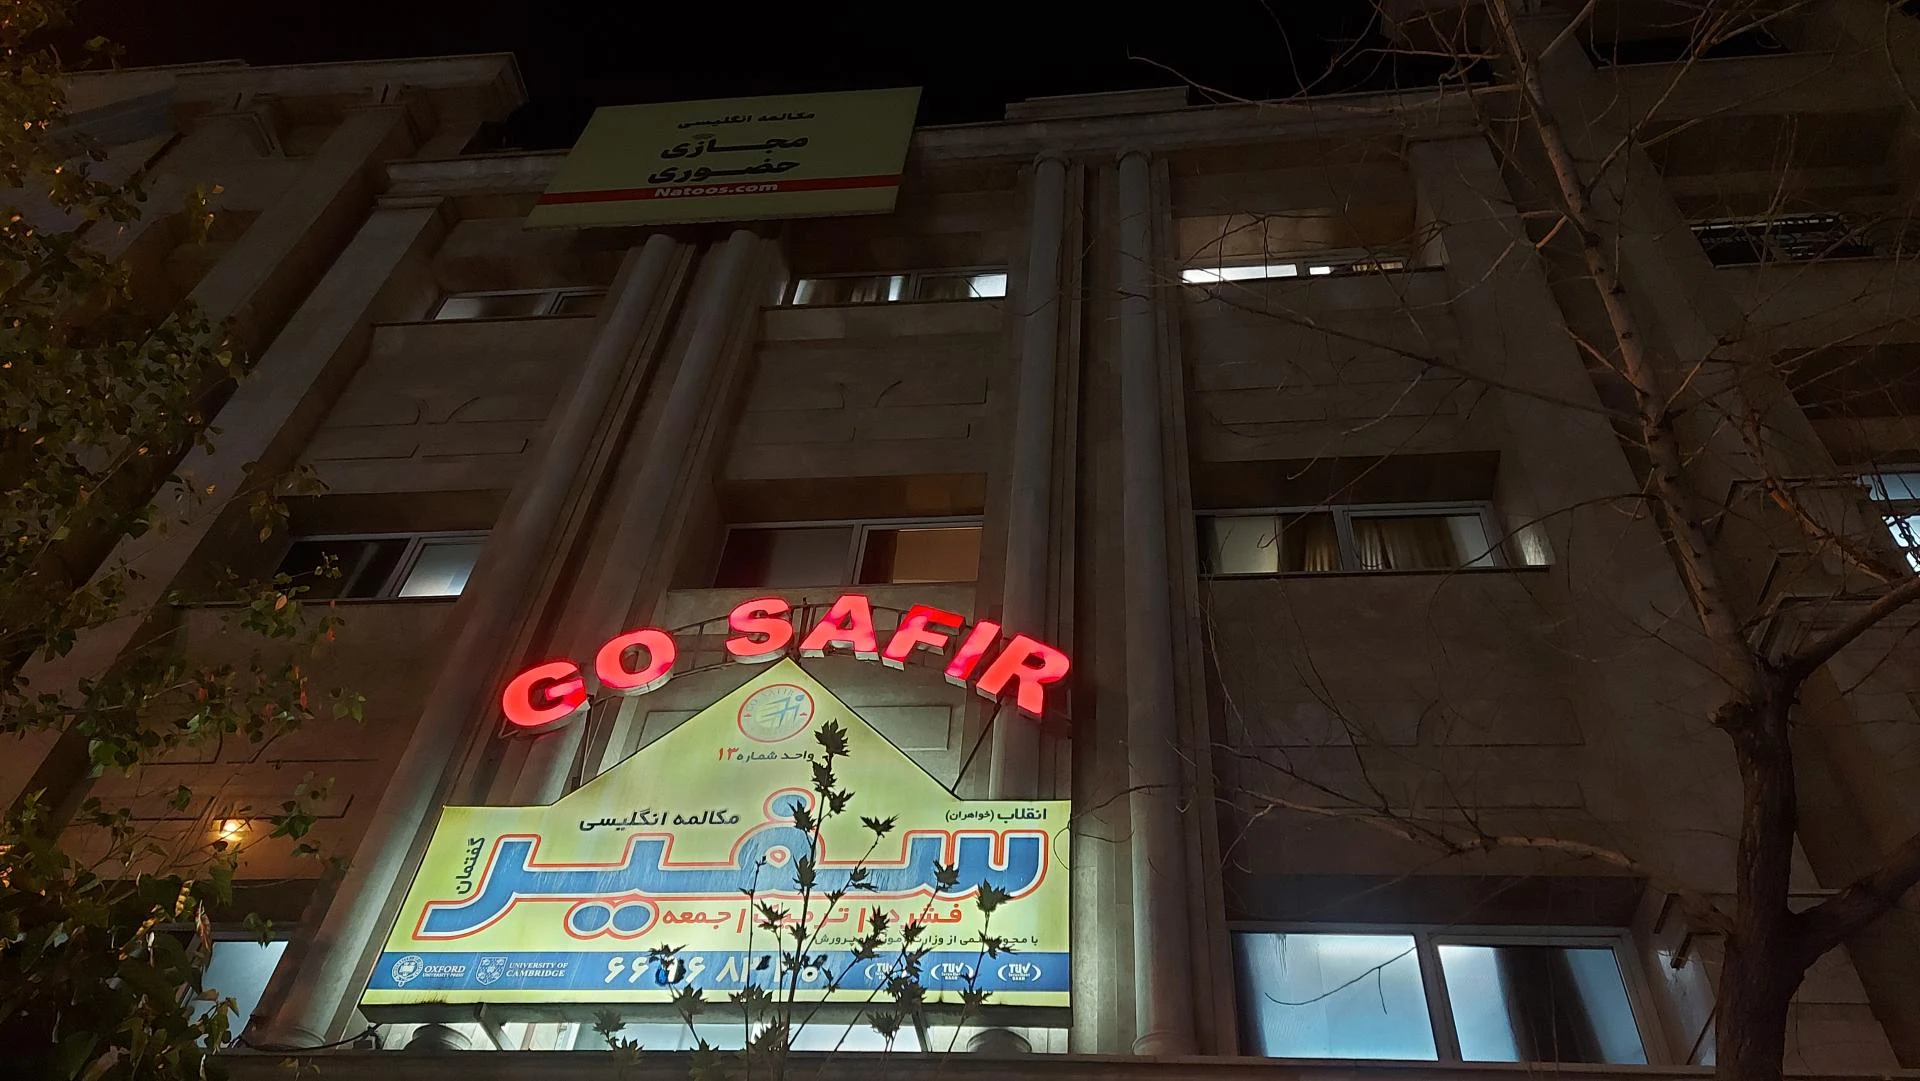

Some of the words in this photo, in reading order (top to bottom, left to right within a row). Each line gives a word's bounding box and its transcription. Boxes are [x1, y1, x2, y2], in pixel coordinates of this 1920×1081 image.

[677, 115, 752, 129] انگلیسی
[757, 111, 815, 124] مکالمه
[660, 134, 808, 160] مجازی
[647, 157, 800, 184] حضوری
[653, 182, 778, 198] Natoos.com
[502, 626, 678, 730] GO
[725, 594, 1071, 717] SAFIR
[737, 751, 778, 763] شماره
[781, 750, 815, 762] واحد
[578, 807, 667, 832] انگلیسی
[673, 807, 740, 826] مکالمه
[945, 809, 995, 823] (خواهران)
[997, 807, 1047, 823] انقلاب
[412, 787, 1049, 941] سفیر
[455, 836, 486, 895] گفتمان
[662, 909, 732, 930] جمعه
[869, 903, 963, 929] فشرد
[424, 965, 466, 973] OXFORD
